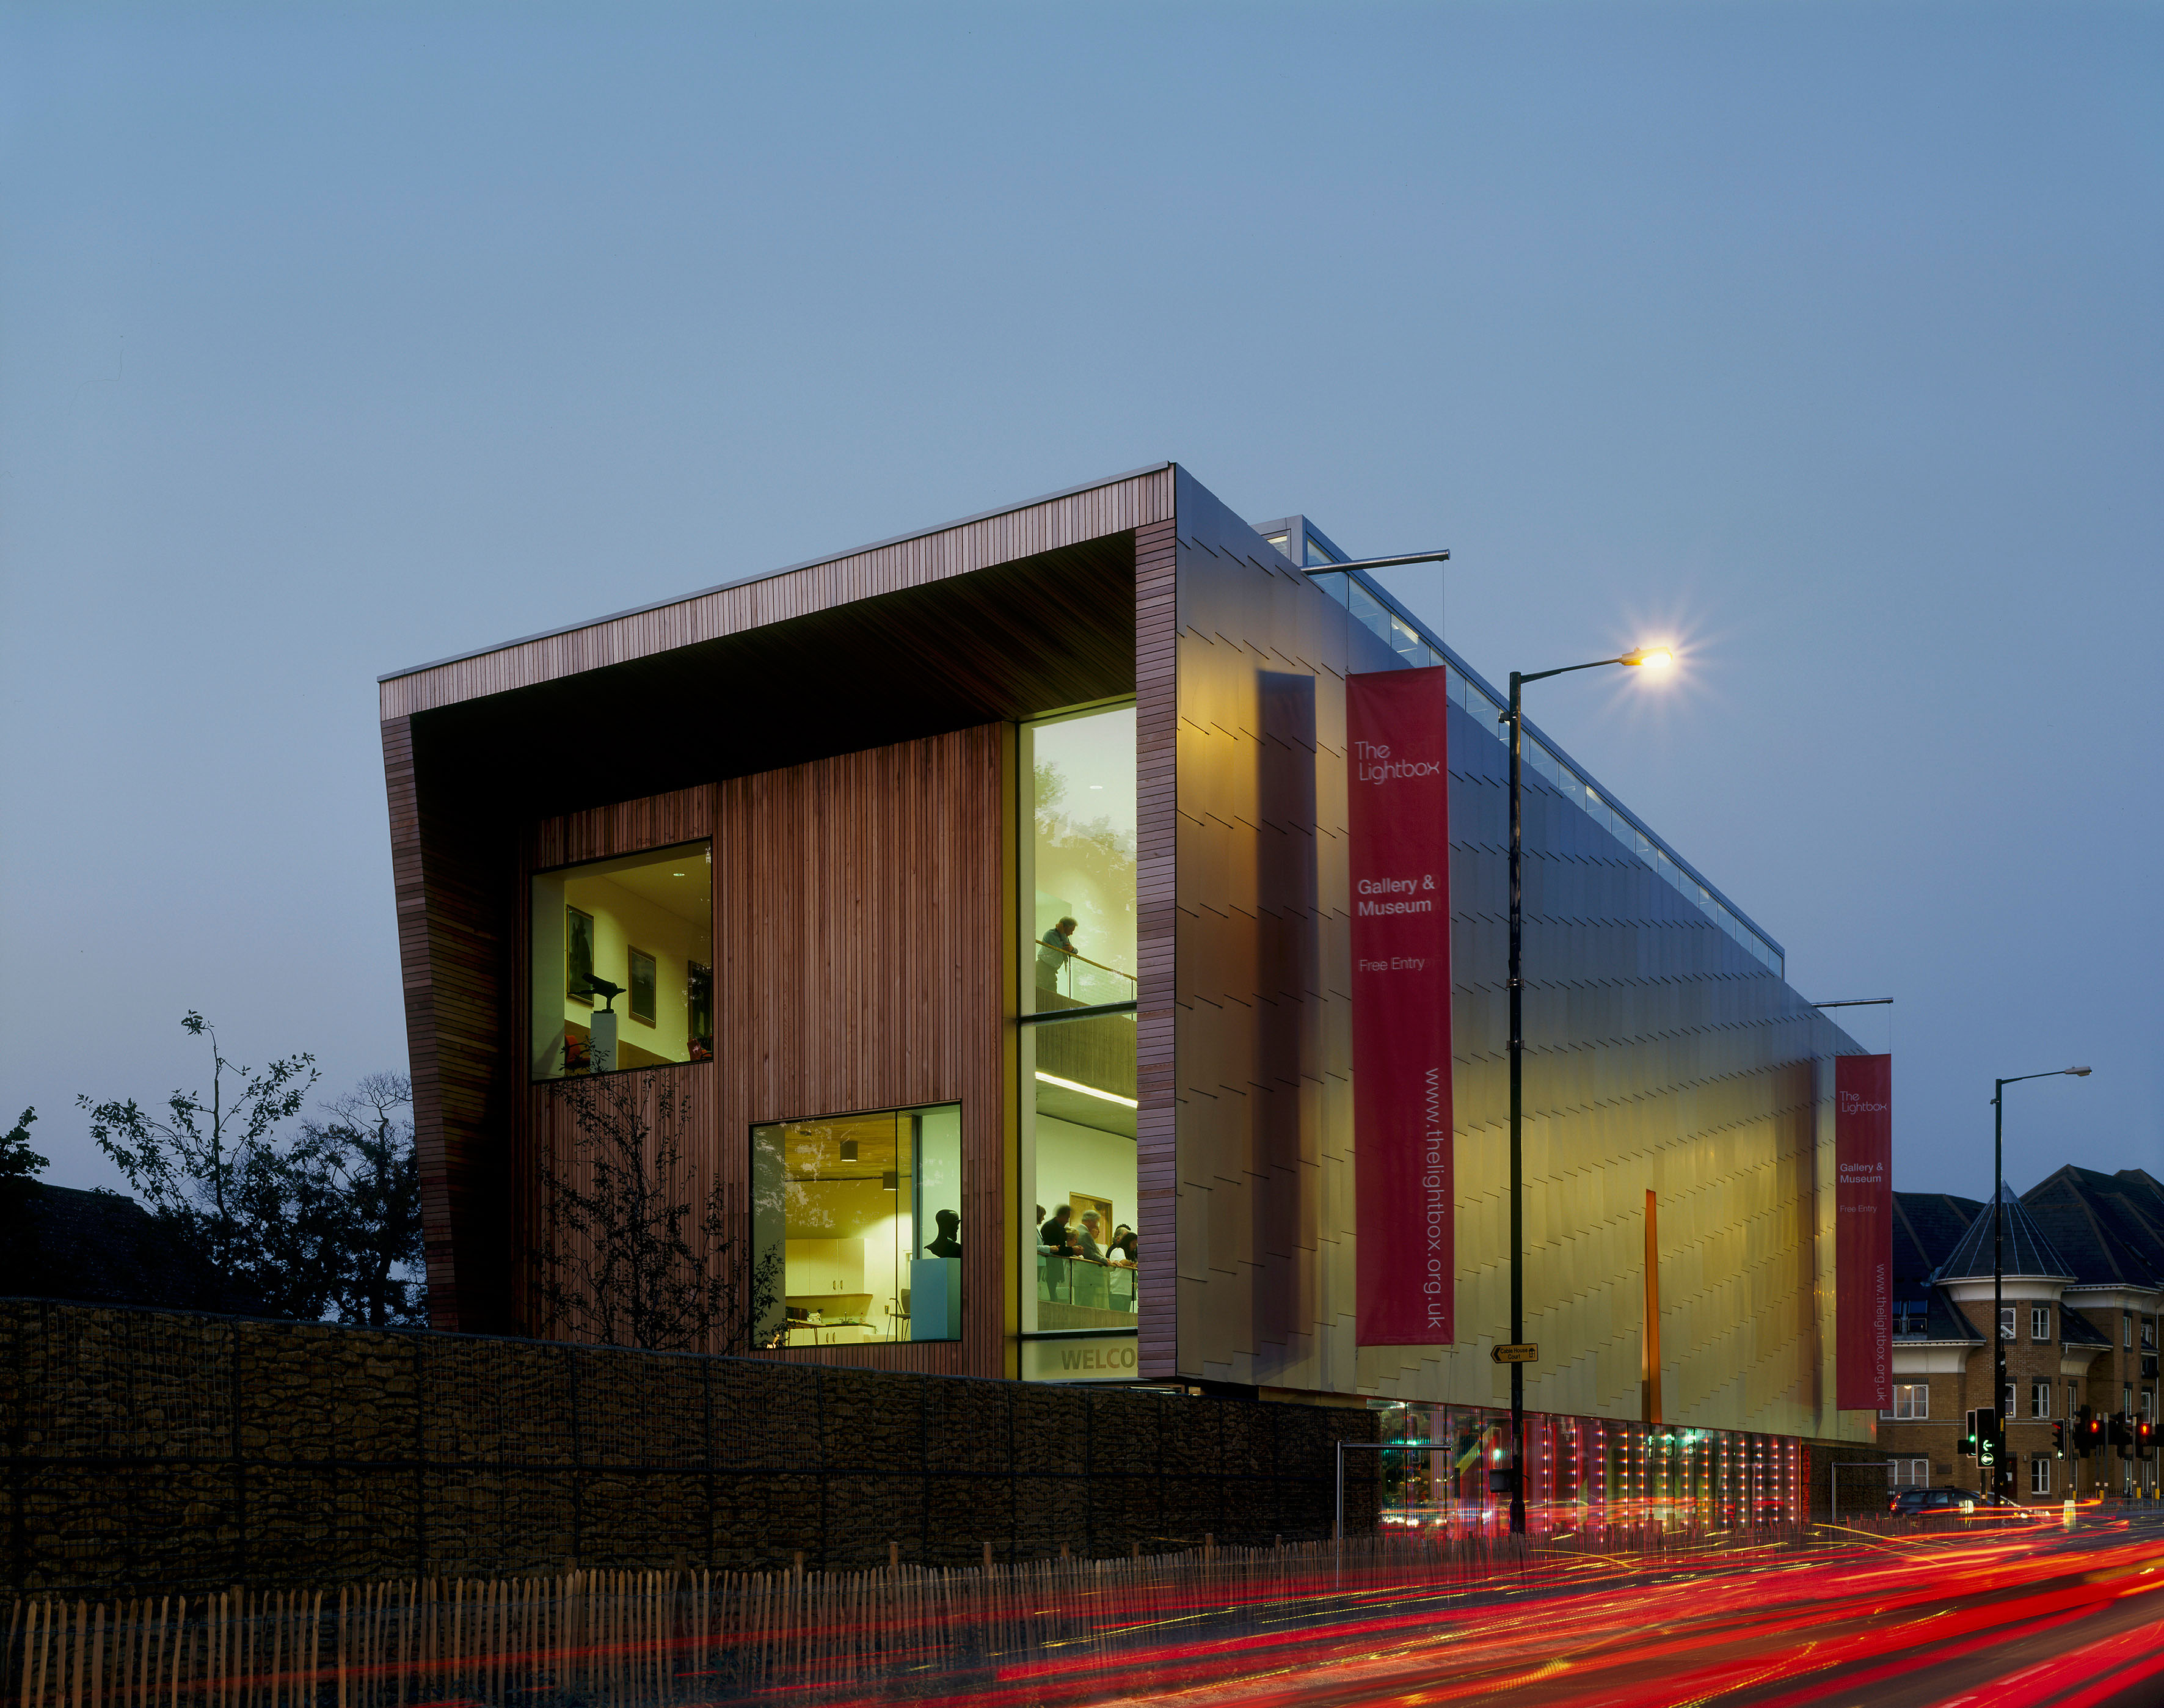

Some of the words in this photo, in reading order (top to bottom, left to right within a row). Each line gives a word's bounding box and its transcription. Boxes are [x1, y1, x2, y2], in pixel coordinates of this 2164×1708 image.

[1354, 740, 1391, 762] The
[1359, 759, 1440, 785] Lightbox
[1358, 876, 1418, 895] Gallery
[1422, 874, 1435, 890] &
[1358, 897, 1432, 916] Museum
[1359, 958, 1388, 972] Free
[1391, 956, 1426, 972] Entry
[1840, 1090, 1860, 1101] The
[1842, 1101, 1887, 1115] Lightbox
[1840, 1162, 1874, 1173] Gallery
[1876, 1162, 1884, 1171] &
[1840, 1175, 1882, 1183] Museum
[1423, 1067, 1445, 1329] www.thelightbox.org.uk
[1858, 1205, 1878, 1214] Entry
[1874, 1263, 1887, 1402] www.thelightbox.org.uk
[1060, 1347, 1136, 1370] WELCO
